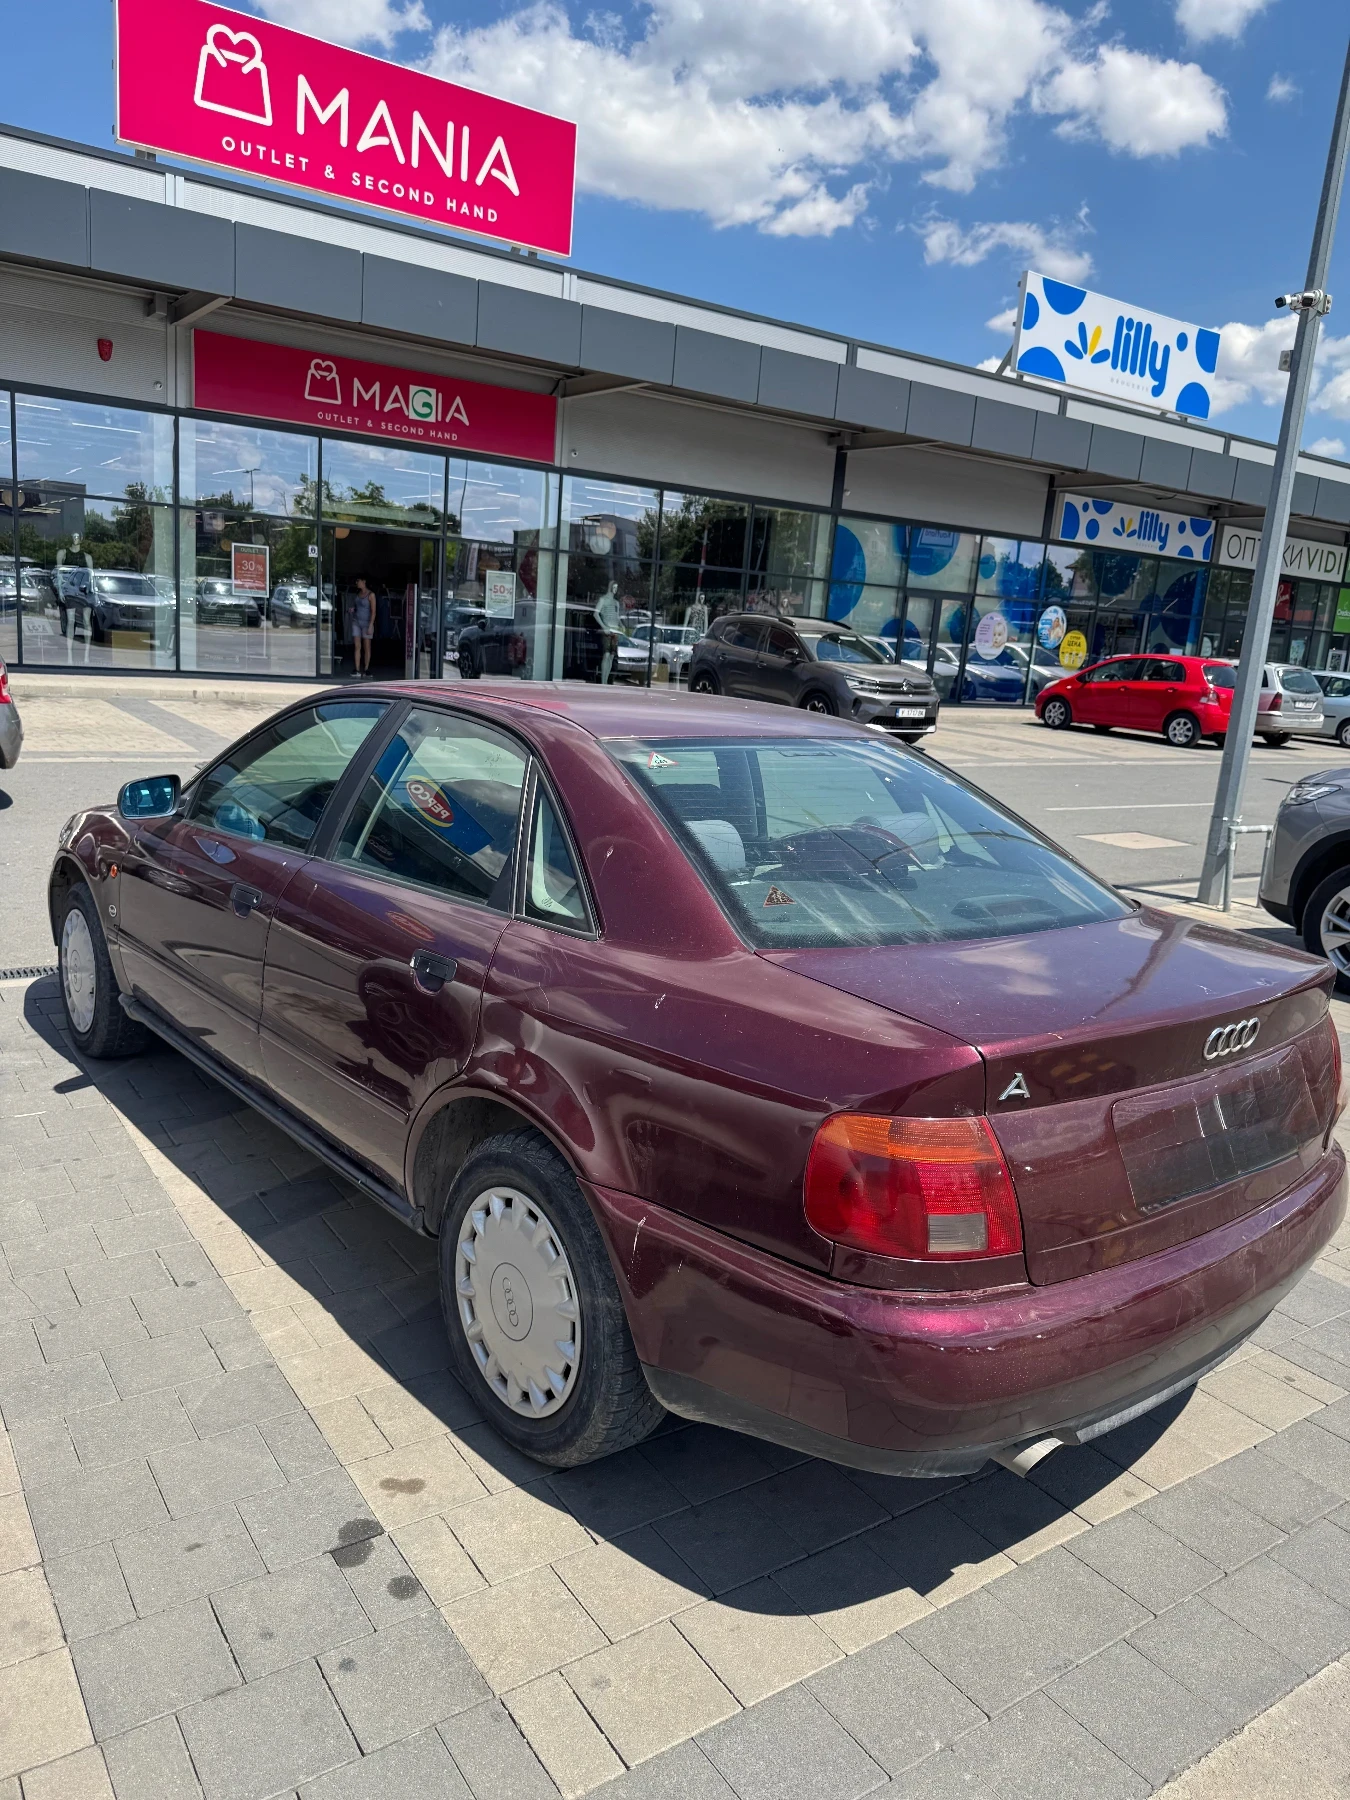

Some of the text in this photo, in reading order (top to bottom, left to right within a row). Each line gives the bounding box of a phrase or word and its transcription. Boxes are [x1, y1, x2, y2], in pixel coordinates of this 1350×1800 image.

[296, 73, 521, 197] MANIA
[221, 136, 499, 223] OUTLET & SECOND HAND
[1111, 315, 1171, 398] lilly
[317, 411, 459, 441] OUTLET & SECOND HAND
[352, 377, 470, 427] MAGIA
[1137, 510, 1170, 552] lilly
[1307, 546, 1344, 575] VIDI
